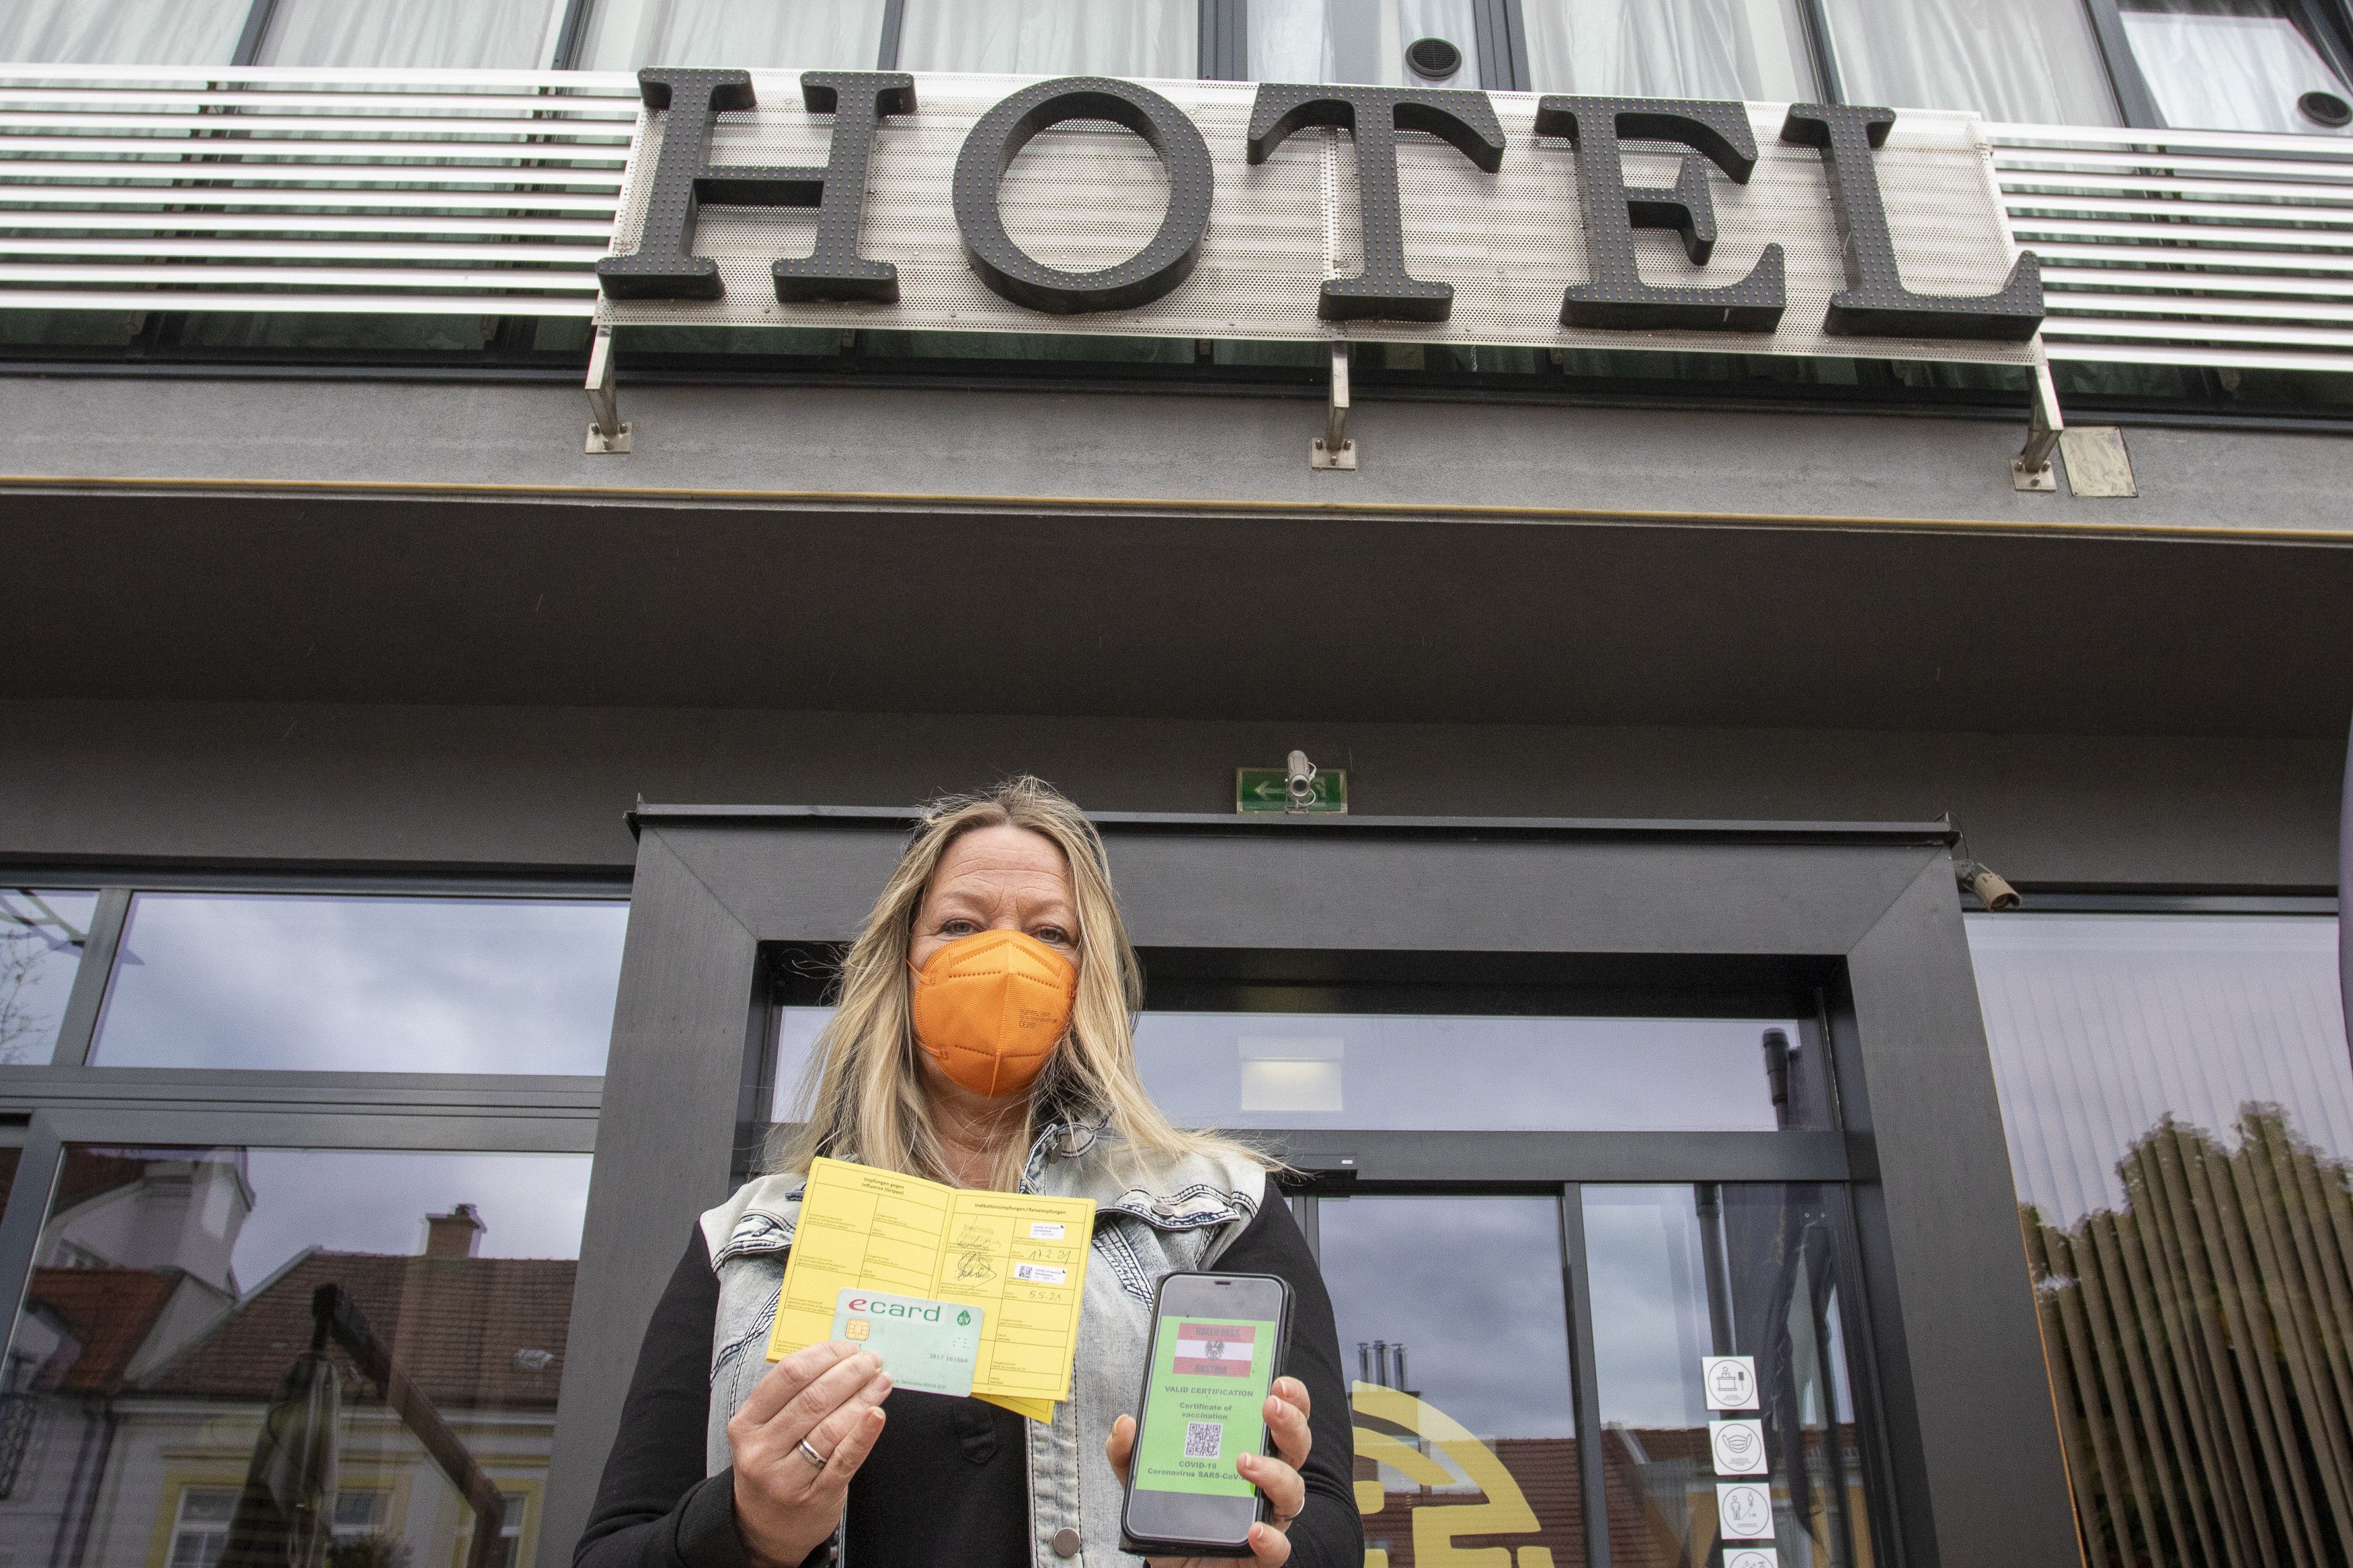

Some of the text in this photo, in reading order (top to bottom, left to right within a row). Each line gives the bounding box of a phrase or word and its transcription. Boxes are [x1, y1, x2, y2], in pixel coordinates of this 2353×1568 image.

[597, 67, 2045, 338] HOTEL
[864, 1178, 889, 1186] Impfungen
[884, 1187, 904, 1196] (Grippe)
[1165, 1385, 1254, 1397] VALID CERTIFICATION
[1179, 1402, 1222, 1411] Certificate
[1182, 1412, 1228, 1420] vaccination
[1179, 1460, 1217, 1470] COVID-19
[1148, 1468, 1195, 1477] Coronavirus
